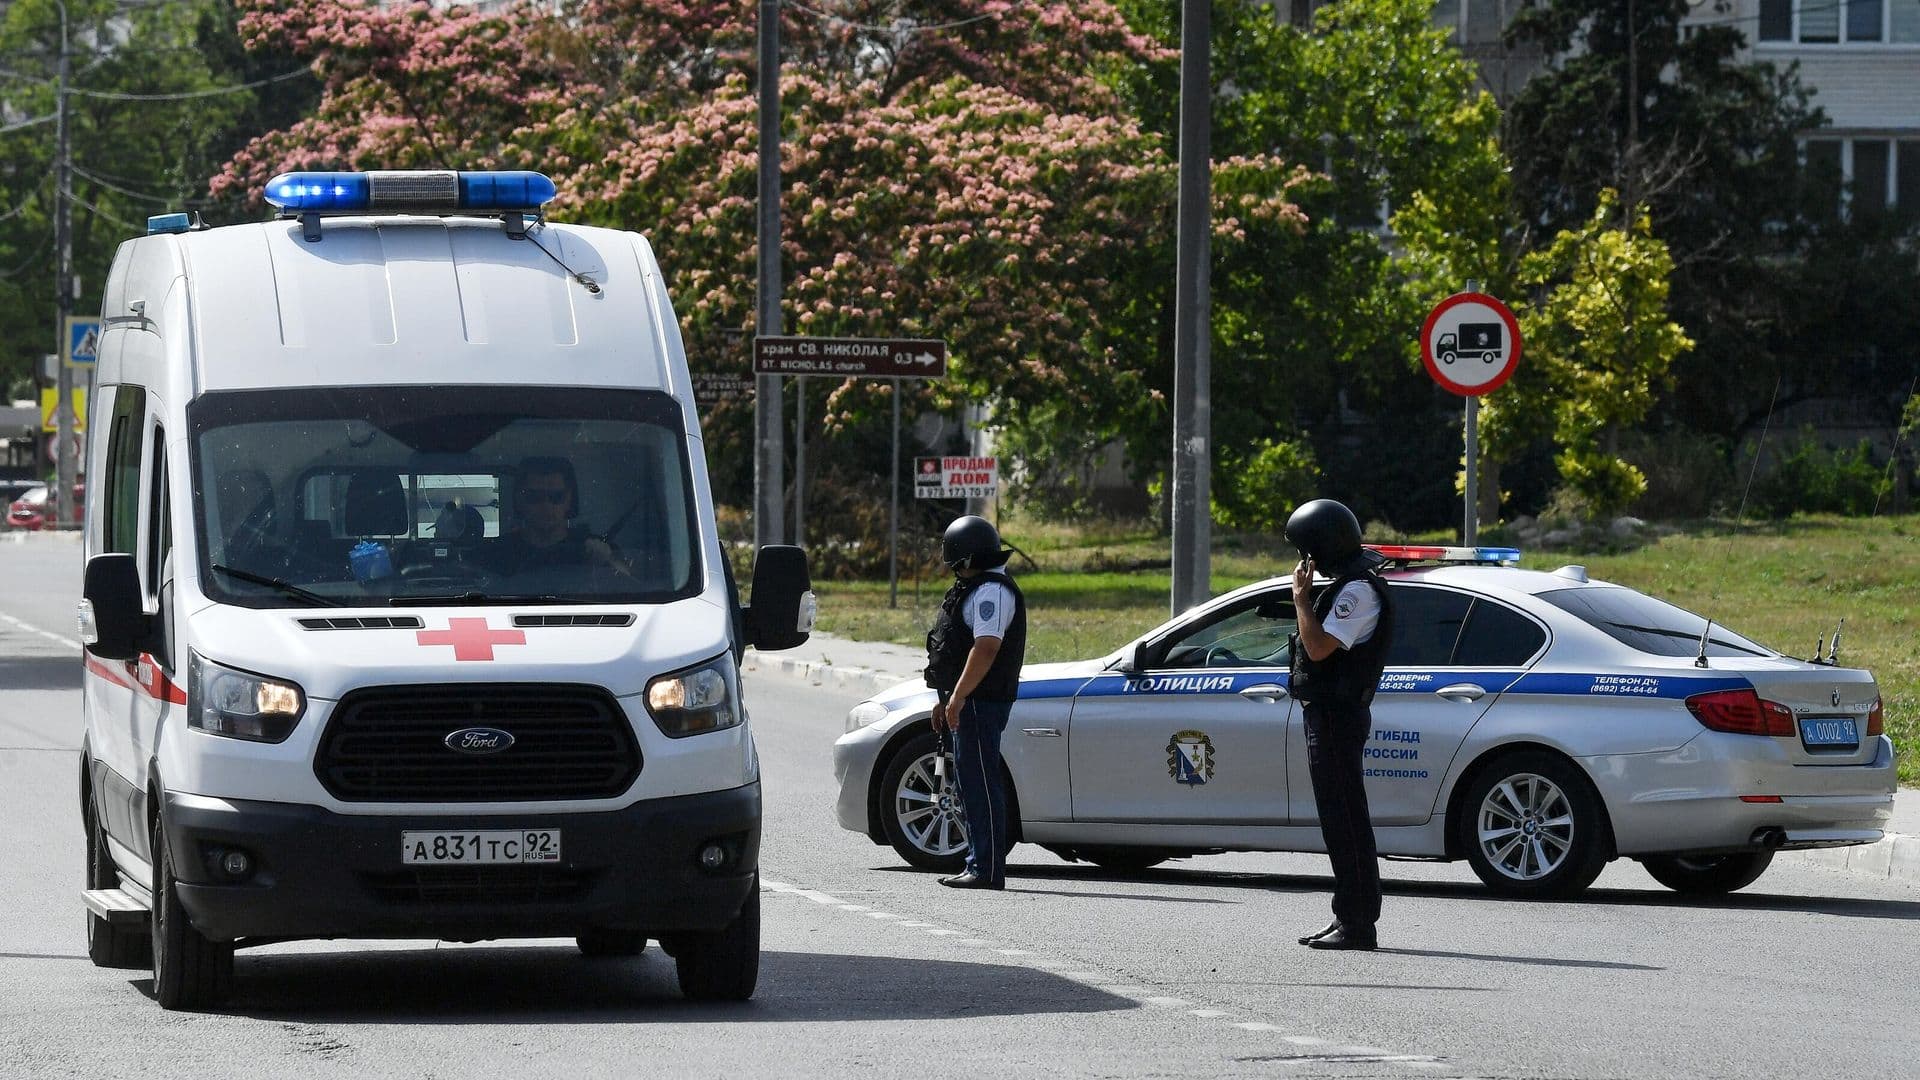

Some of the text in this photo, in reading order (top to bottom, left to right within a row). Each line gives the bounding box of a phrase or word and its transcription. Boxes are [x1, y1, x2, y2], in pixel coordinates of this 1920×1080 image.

[762, 343, 889, 357] храм СВ. НИКОЛАЯ
[780, 361, 832, 371] NICHOLAS
[836, 363, 866, 371] church
[943, 458, 995, 470] ПРОДАМ
[950, 473, 989, 485] ДОМ
[1386, 674, 1434, 682] ДОВЕРИЯ:
[1595, 676, 1660, 686] ТЕЛЕФОН ДЧ:
[1123, 677, 1235, 692] ПОЛИЦИЯ
[1380, 682, 1416, 690] 55-02-02
[1591, 684, 1658, 694] (8692) 54-64-64
[1843, 721, 1854, 736] 92
[461, 731, 499, 748] Ford
[1375, 730, 1421, 743] ГИБДД
[1364, 748, 1418, 760] РОССИИ
[526, 832, 551, 852] 92
[525, 852, 544, 860] RUS
